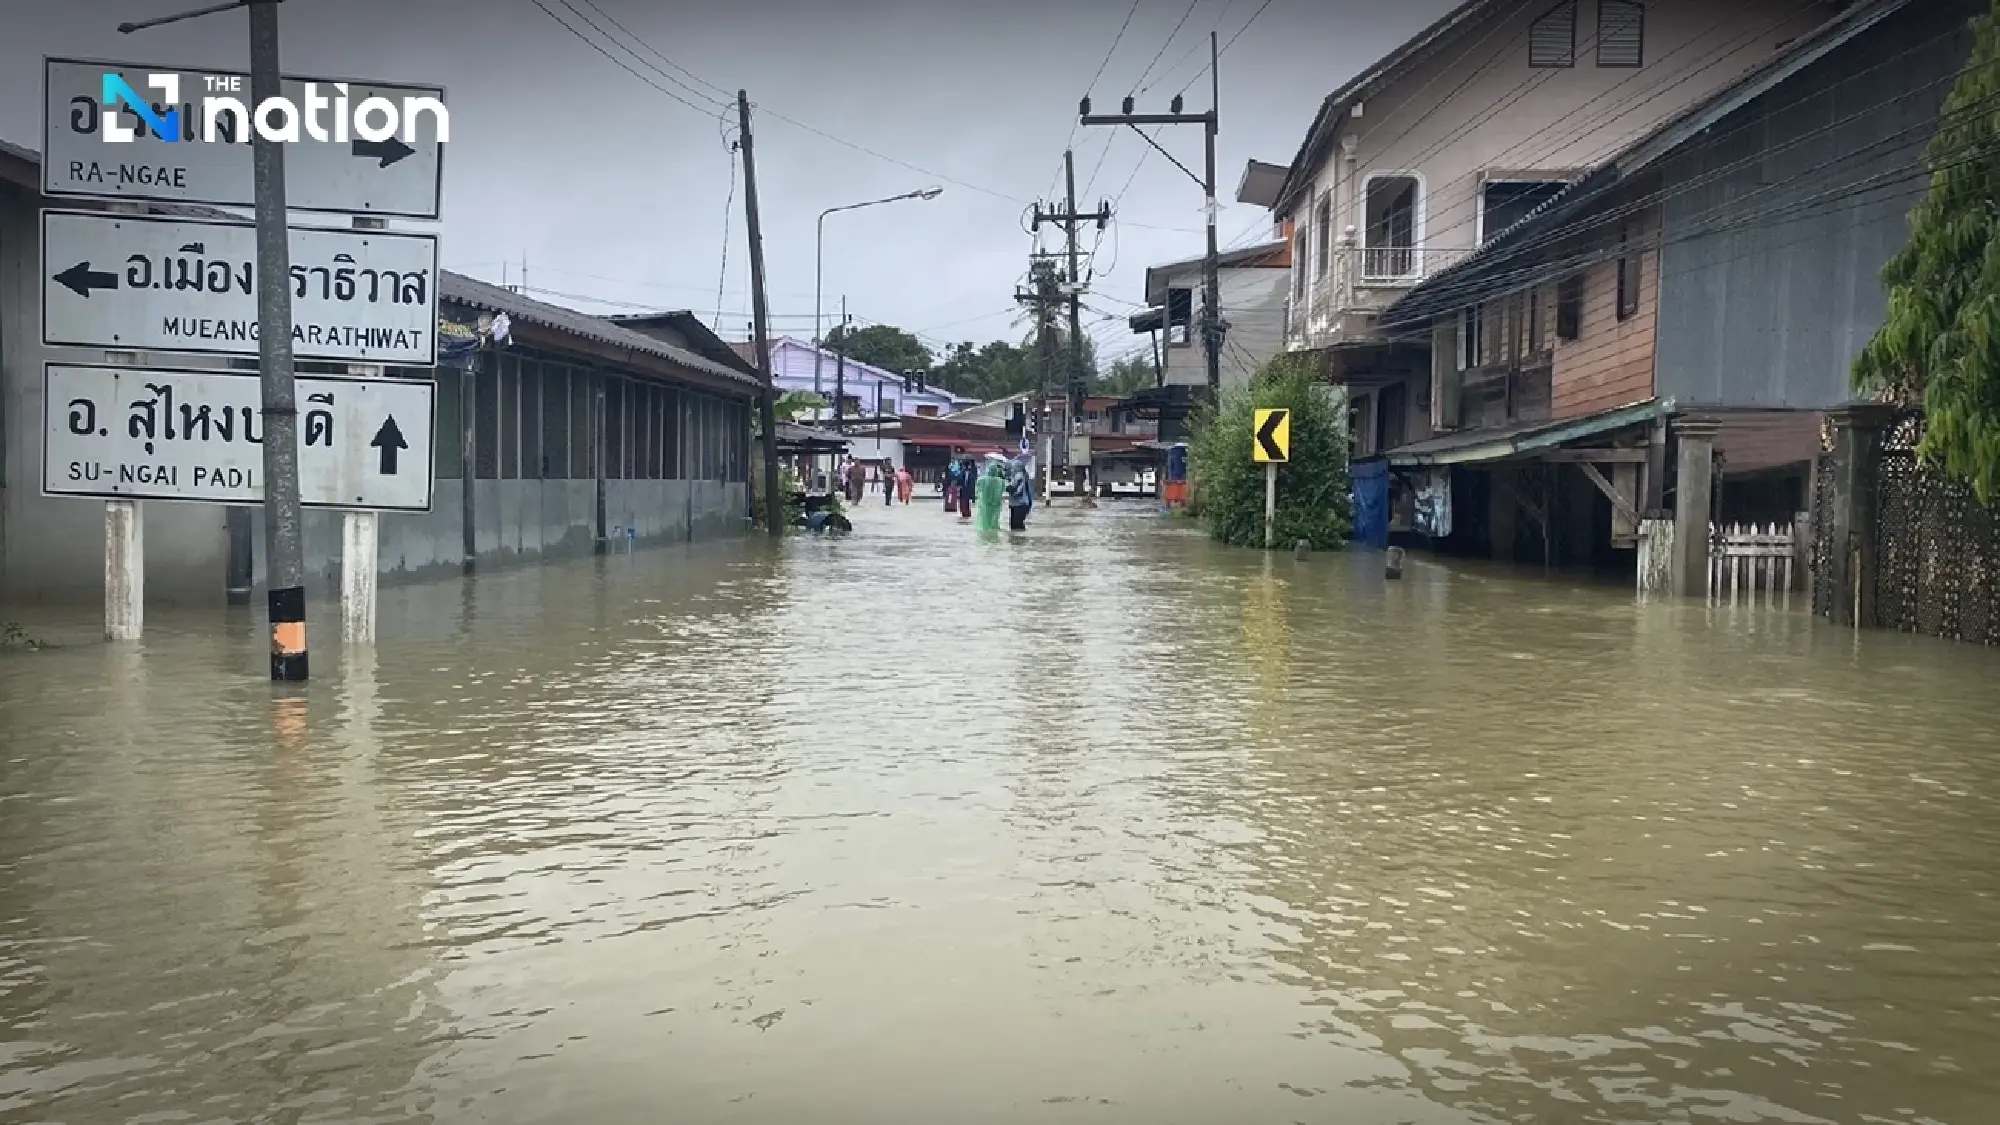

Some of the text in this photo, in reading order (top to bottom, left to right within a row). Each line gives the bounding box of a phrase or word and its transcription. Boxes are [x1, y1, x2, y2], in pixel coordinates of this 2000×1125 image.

[70, 161, 186, 188] RA-NGAE
[126, 242, 428, 305] อ.เมืองราธิวาส
[291, 323, 423, 349] ARATHIWAT
[68, 398, 109, 436] อ.
[68, 462, 252, 489] SU-NGAI PADI
